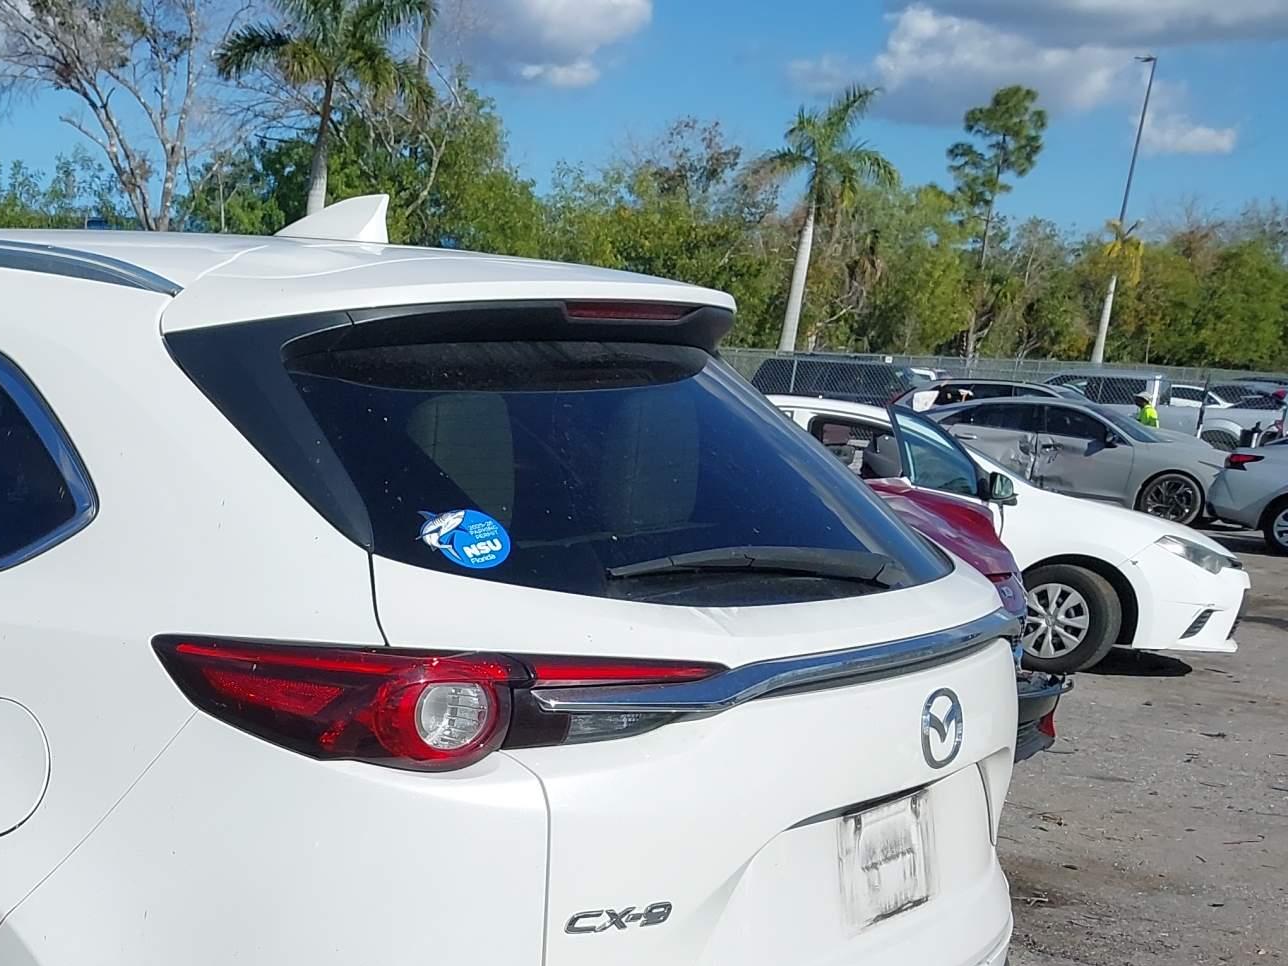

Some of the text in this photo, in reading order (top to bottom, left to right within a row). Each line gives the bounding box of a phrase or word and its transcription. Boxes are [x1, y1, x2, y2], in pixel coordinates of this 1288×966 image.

[463, 538, 502, 558] NSU
[471, 554, 496, 564] Florida
[564, 901, 672, 934] CX-9
